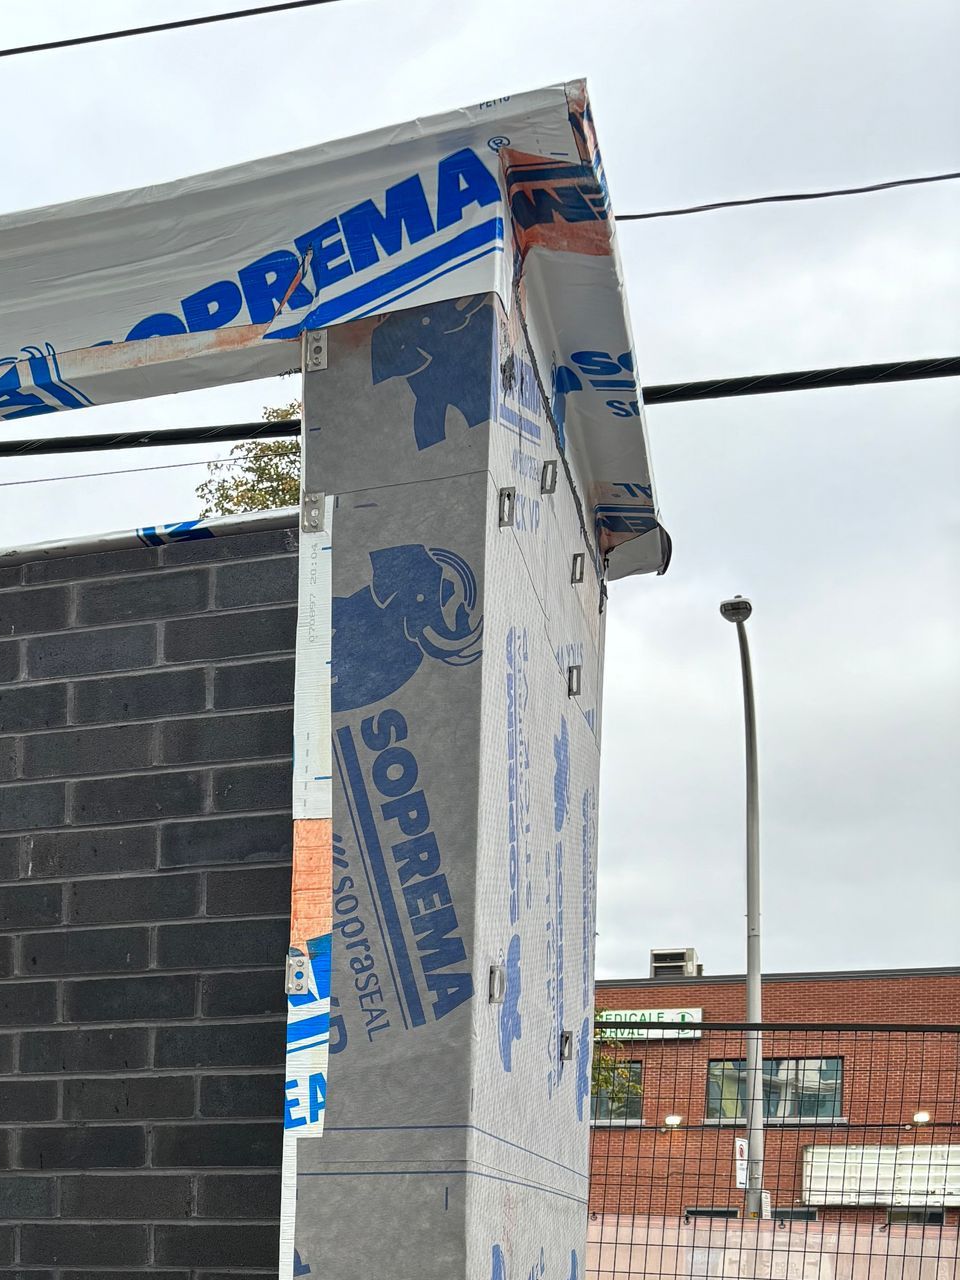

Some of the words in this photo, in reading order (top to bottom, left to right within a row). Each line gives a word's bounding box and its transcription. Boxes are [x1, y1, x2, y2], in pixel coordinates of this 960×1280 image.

[92, 147, 502, 343] PREMA
[358, 708, 475, 1028] SOPREMA
[505, 626, 518, 926] SOPREMA
